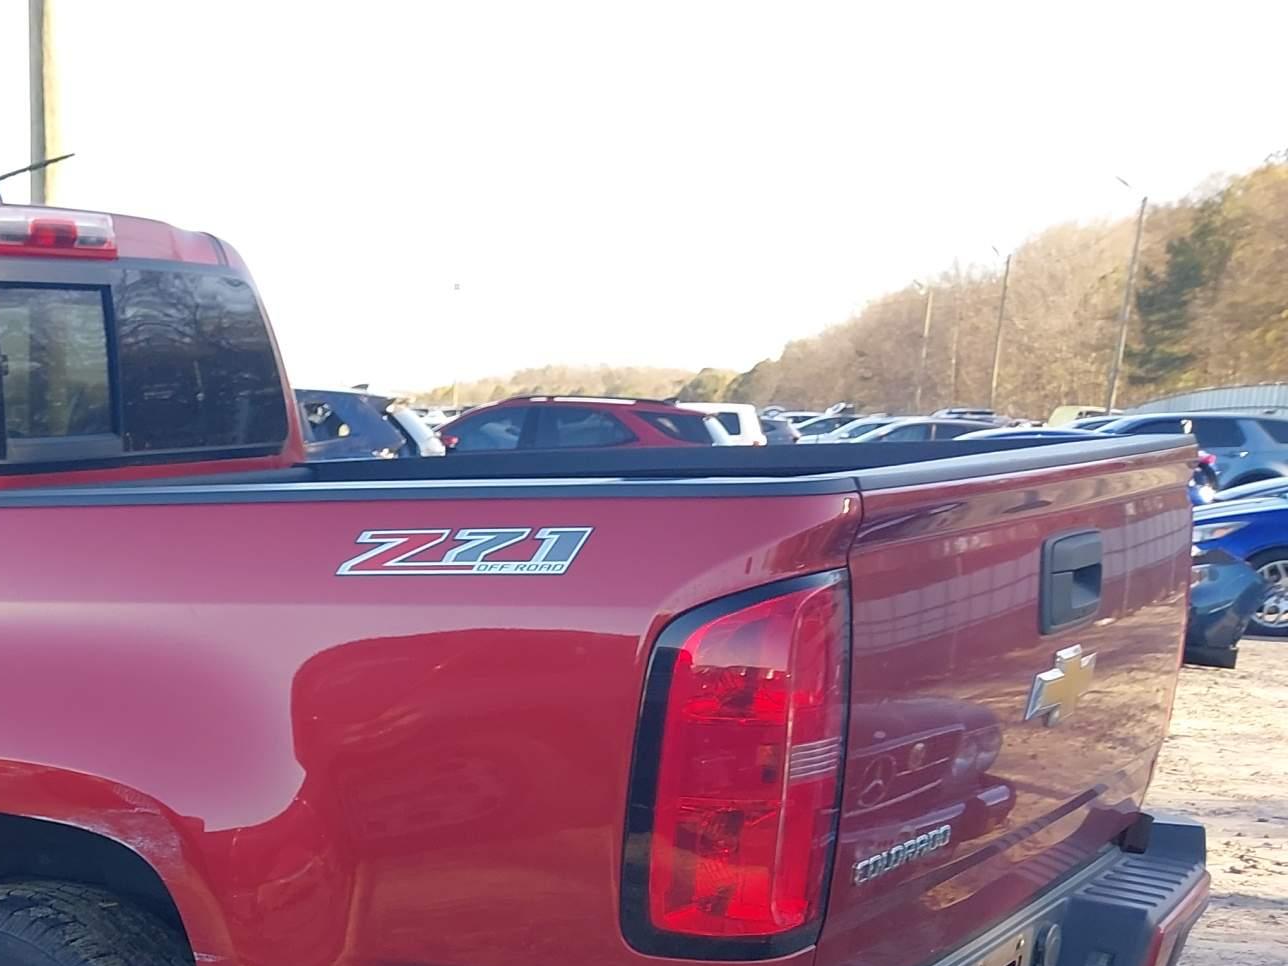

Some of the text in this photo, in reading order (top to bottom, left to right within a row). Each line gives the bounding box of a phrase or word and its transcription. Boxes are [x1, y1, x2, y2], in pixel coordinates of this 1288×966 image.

[335, 527, 593, 575] Z71
[476, 563, 565, 572] OFF ROAD
[853, 824, 952, 884] COLORADO
